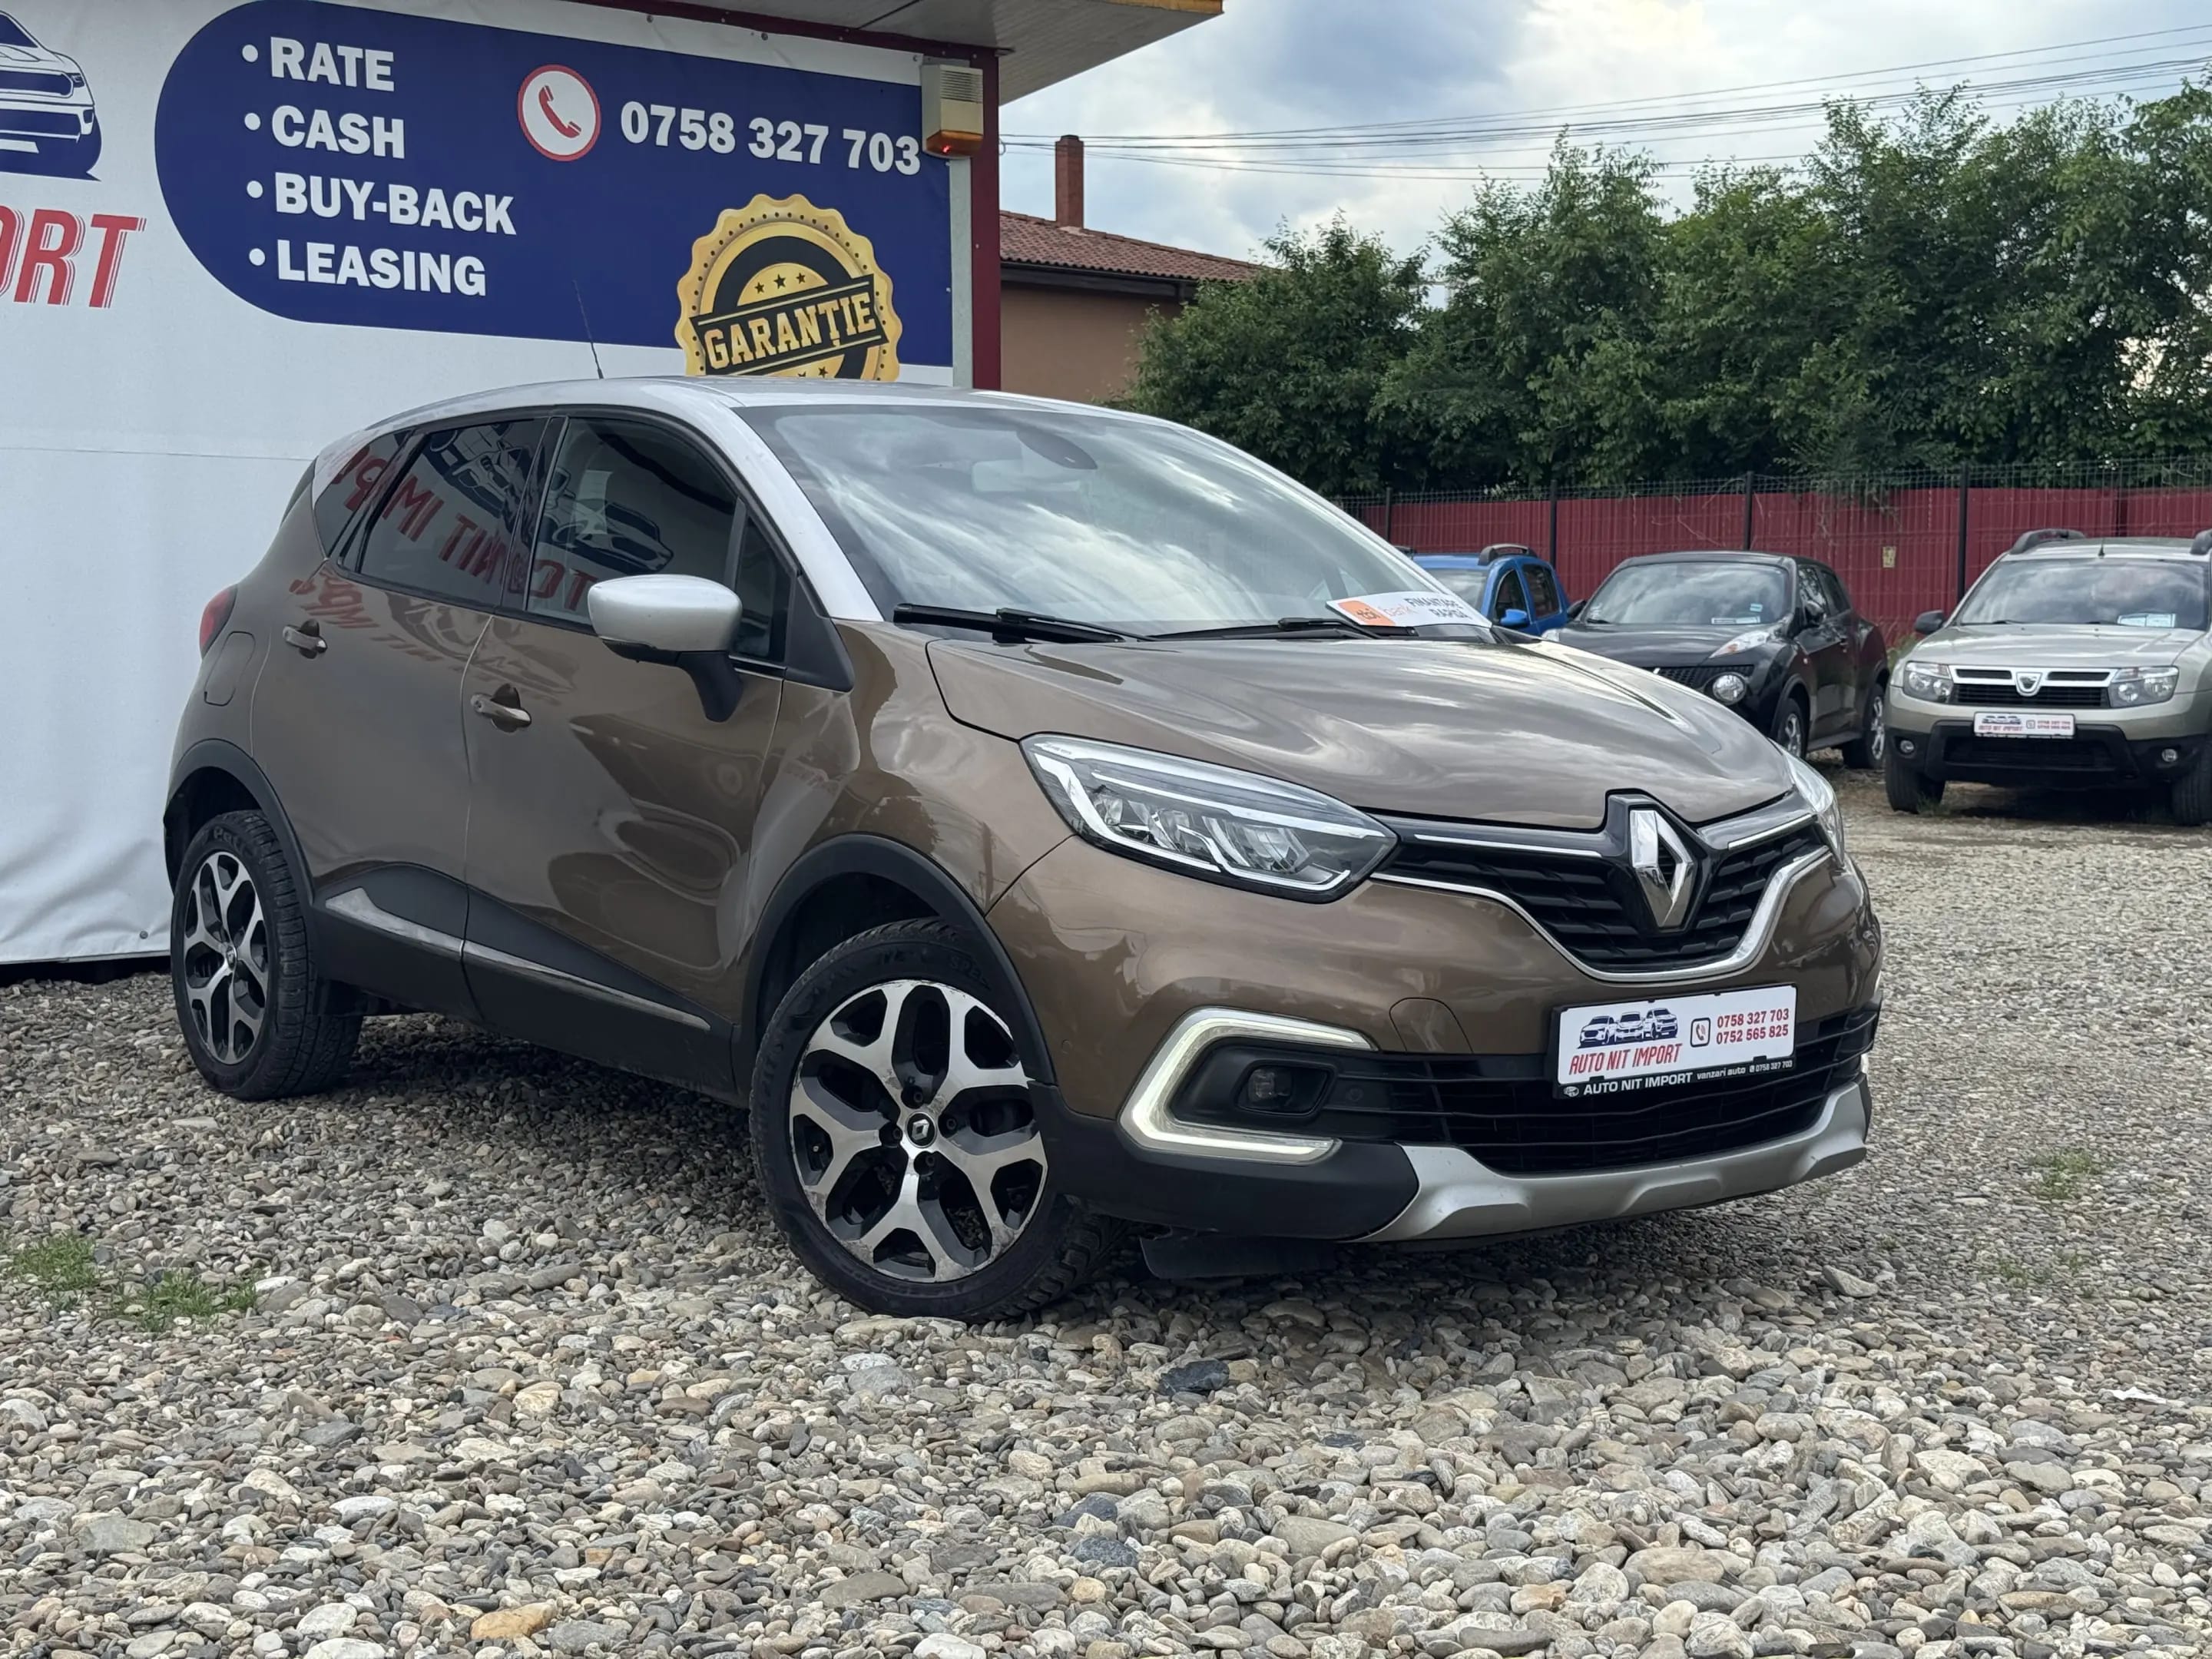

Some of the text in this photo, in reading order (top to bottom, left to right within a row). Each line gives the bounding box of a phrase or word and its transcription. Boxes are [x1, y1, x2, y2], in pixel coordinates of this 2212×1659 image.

[270, 36, 395, 92] RATE
[271, 104, 406, 160] CASH
[621, 101, 922, 176] 0758 327 703
[275, 171, 517, 235] BUY-BACK
[277, 239, 487, 296] LEASING
[1716, 1024, 1789, 1045] 0752 565 825
[1717, 1008, 1790, 1028] 0758 327 703
[1568, 1043, 1683, 1075] AUTO NIT IMPORT
[1583, 1081, 1618, 1095] AUTO
[1621, 1078, 1643, 1091] NIT
[1645, 1072, 1694, 1088] IMPORT
[1697, 1068, 1727, 1080] vanzari
[1727, 1066, 1746, 1076] auto
